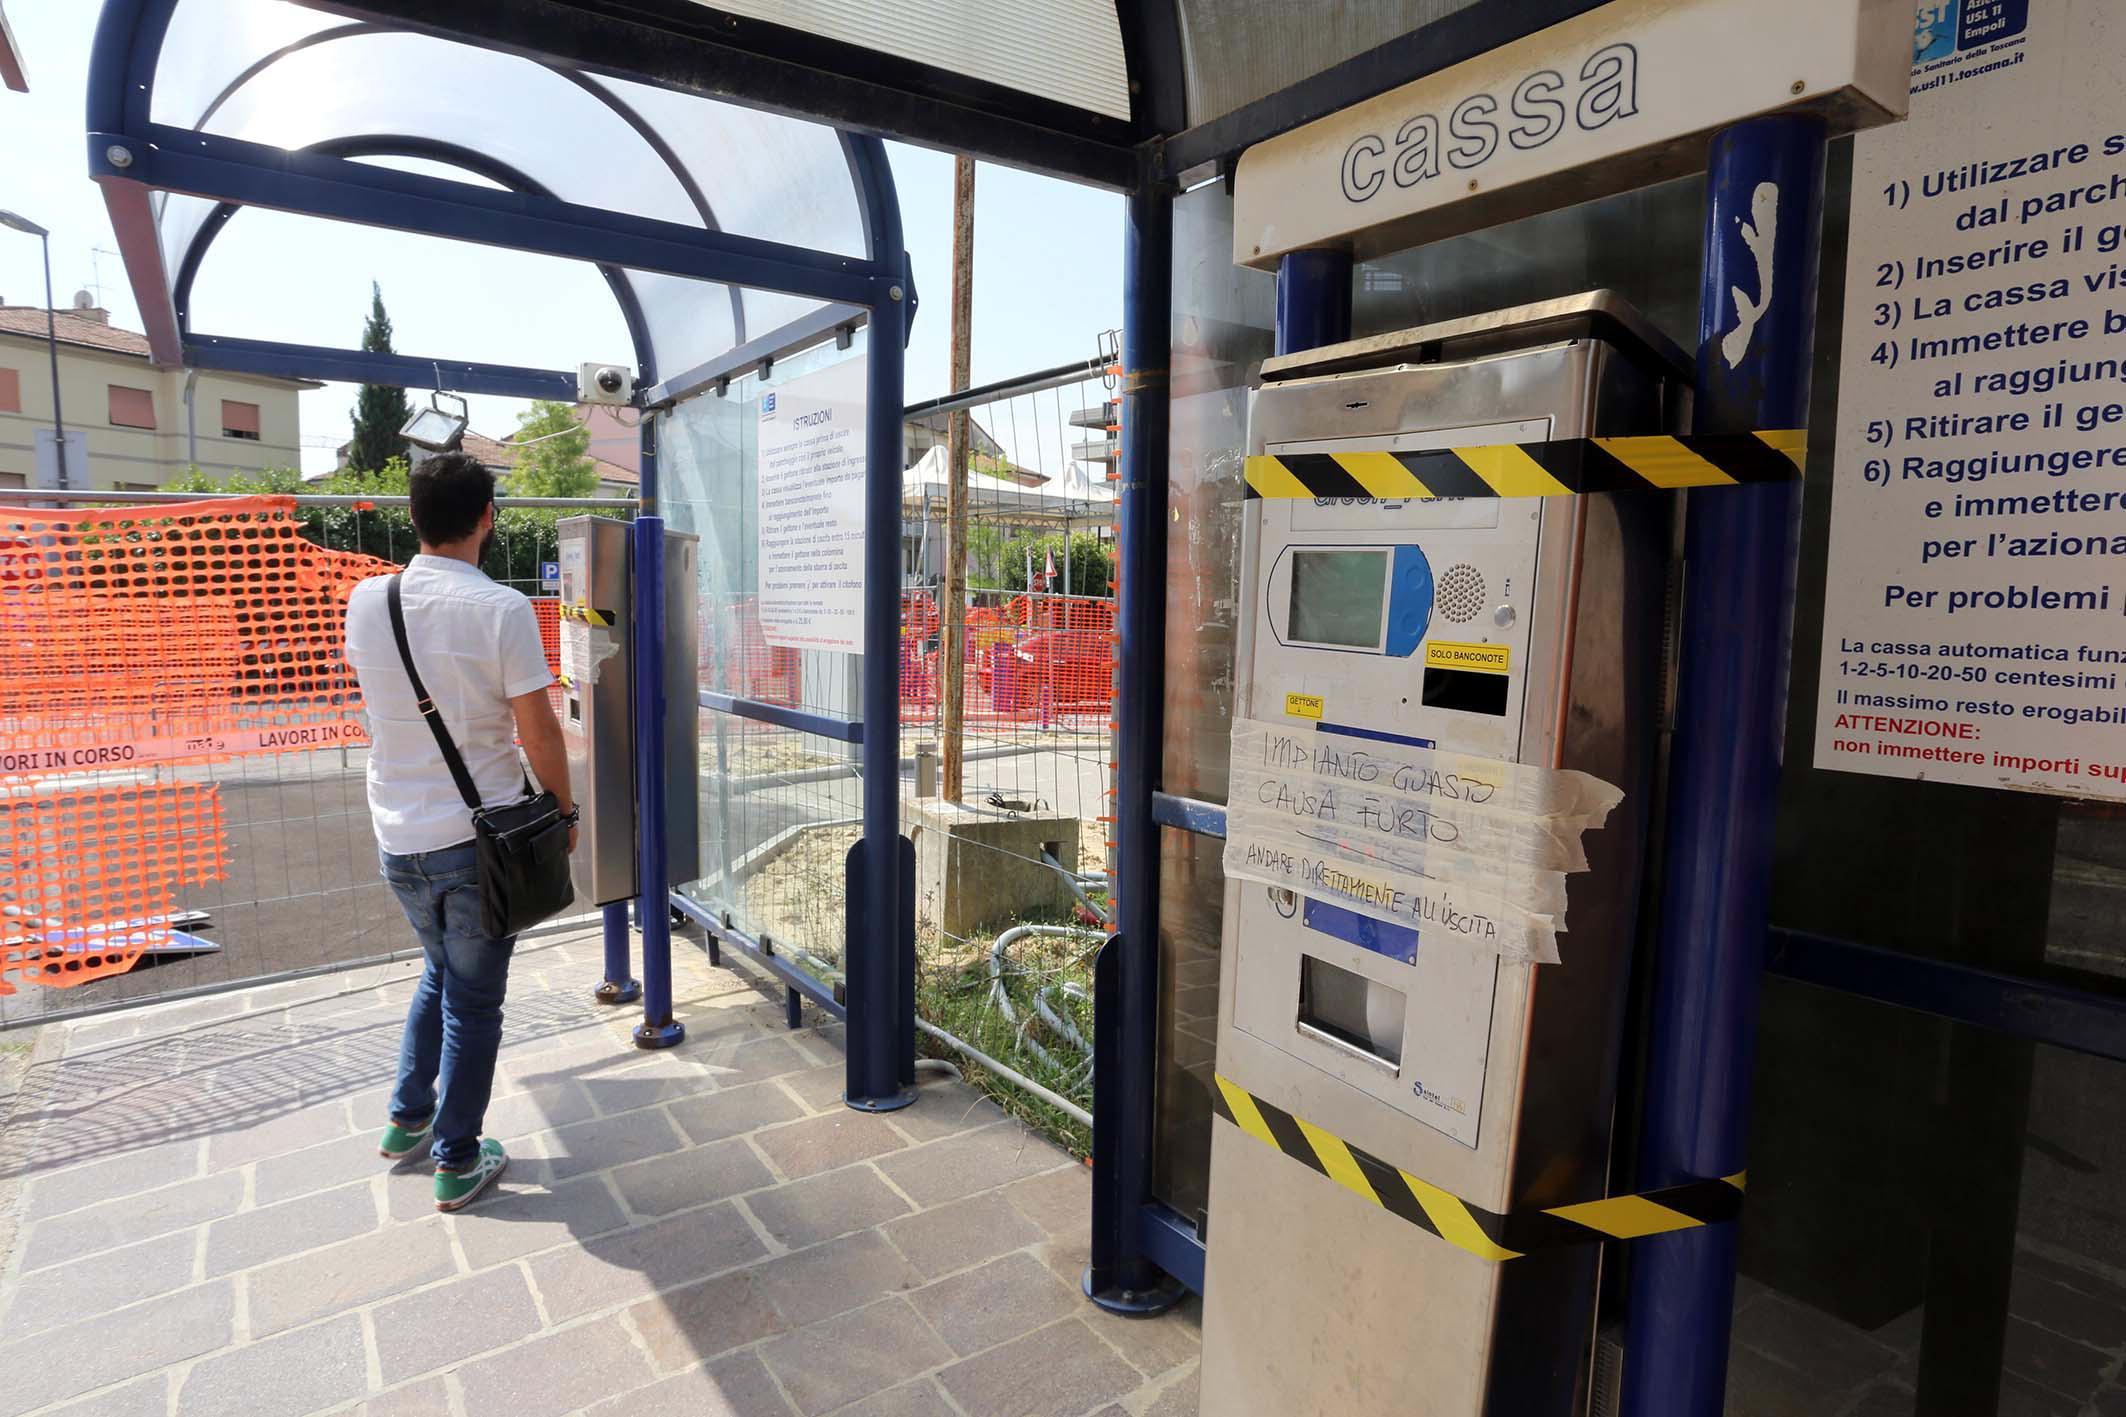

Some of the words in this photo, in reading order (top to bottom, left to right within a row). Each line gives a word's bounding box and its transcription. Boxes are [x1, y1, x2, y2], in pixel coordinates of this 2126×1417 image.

[1964, 17, 2006, 39] Empoli
[1966, 9, 1988, 24] USL
[1992, 4, 2002, 16] 11
[1924, 56, 1963, 73] Sanitario
[1965, 48, 1987, 61] della
[1990, 37, 2026, 53] Toscana
[1341, 42, 1639, 202] cassa
[1884, 181, 1909, 209] 1)
[1923, 144, 2091, 201] Utilizzare
[1956, 199, 2008, 231] dal
[2021, 174, 2126, 224] parch
[1876, 261, 1904, 290] 2)
[1917, 240, 2048, 280] Inserire
[2063, 226, 2083, 253] il
[2098, 225, 2126, 252] g
[1874, 301, 1901, 329] 3)
[1914, 298, 1951, 320] La
[1964, 279, 2069, 311] cassa
[1871, 341, 1898, 369] 4)
[1911, 320, 2088, 360] Immettere
[1934, 373, 1961, 397] al
[793, 408, 832, 431] ISTRUZIONI
[1867, 420, 1893, 448] 5)
[1905, 413, 2029, 440] Ritirare
[2043, 403, 2062, 428] il
[2077, 404, 2123, 431] ge
[1864, 459, 1890, 487] 6)
[1903, 448, 2126, 482] Raggiungere
[1925, 501, 1942, 518] e
[1922, 540, 1977, 563] per
[546, 565, 557, 578] P
[1885, 586, 1939, 607] Per
[1948, 586, 2108, 613] problemi
[1431, 649, 1452, 659] SOLO
[1454, 651, 1504, 663] BANCONOTE
[1841, 638, 1863, 653] La
[1871, 643, 1930, 655] cassa
[1938, 643, 2068, 661] automatica
[1840, 661, 1986, 682] 1-2-5-10-20-50
[1995, 671, 2115, 689] centesimi
[1290, 697, 1319, 708] GETTONE
[1838, 690, 1847, 704] Il
[1855, 694, 1948, 711] massimo
[1956, 701, 2014, 715] resto
[2023, 706, 2126, 724] erogabil
[259, 728, 317, 748] LAVORI
[321, 725, 338, 741] IN
[1835, 715, 1981, 739] ATTENZIONE:
[45, 751, 66, 768] IN
[73, 745, 134, 765] CORSO
[1264, 732, 1379, 781] IMPIANTO
[1393, 766, 1495, 803] GUASTO
[1834, 738, 1870, 753] non
[1878, 742, 1985, 765] immettere
[1994, 751, 2078, 774] importi
[1258, 780, 1336, 819] CAUSA
[1357, 798, 1459, 842] FURTO
[1246, 843, 1294, 873] ANDARE
[1301, 857, 1405, 912] DIRETTAMENTE
